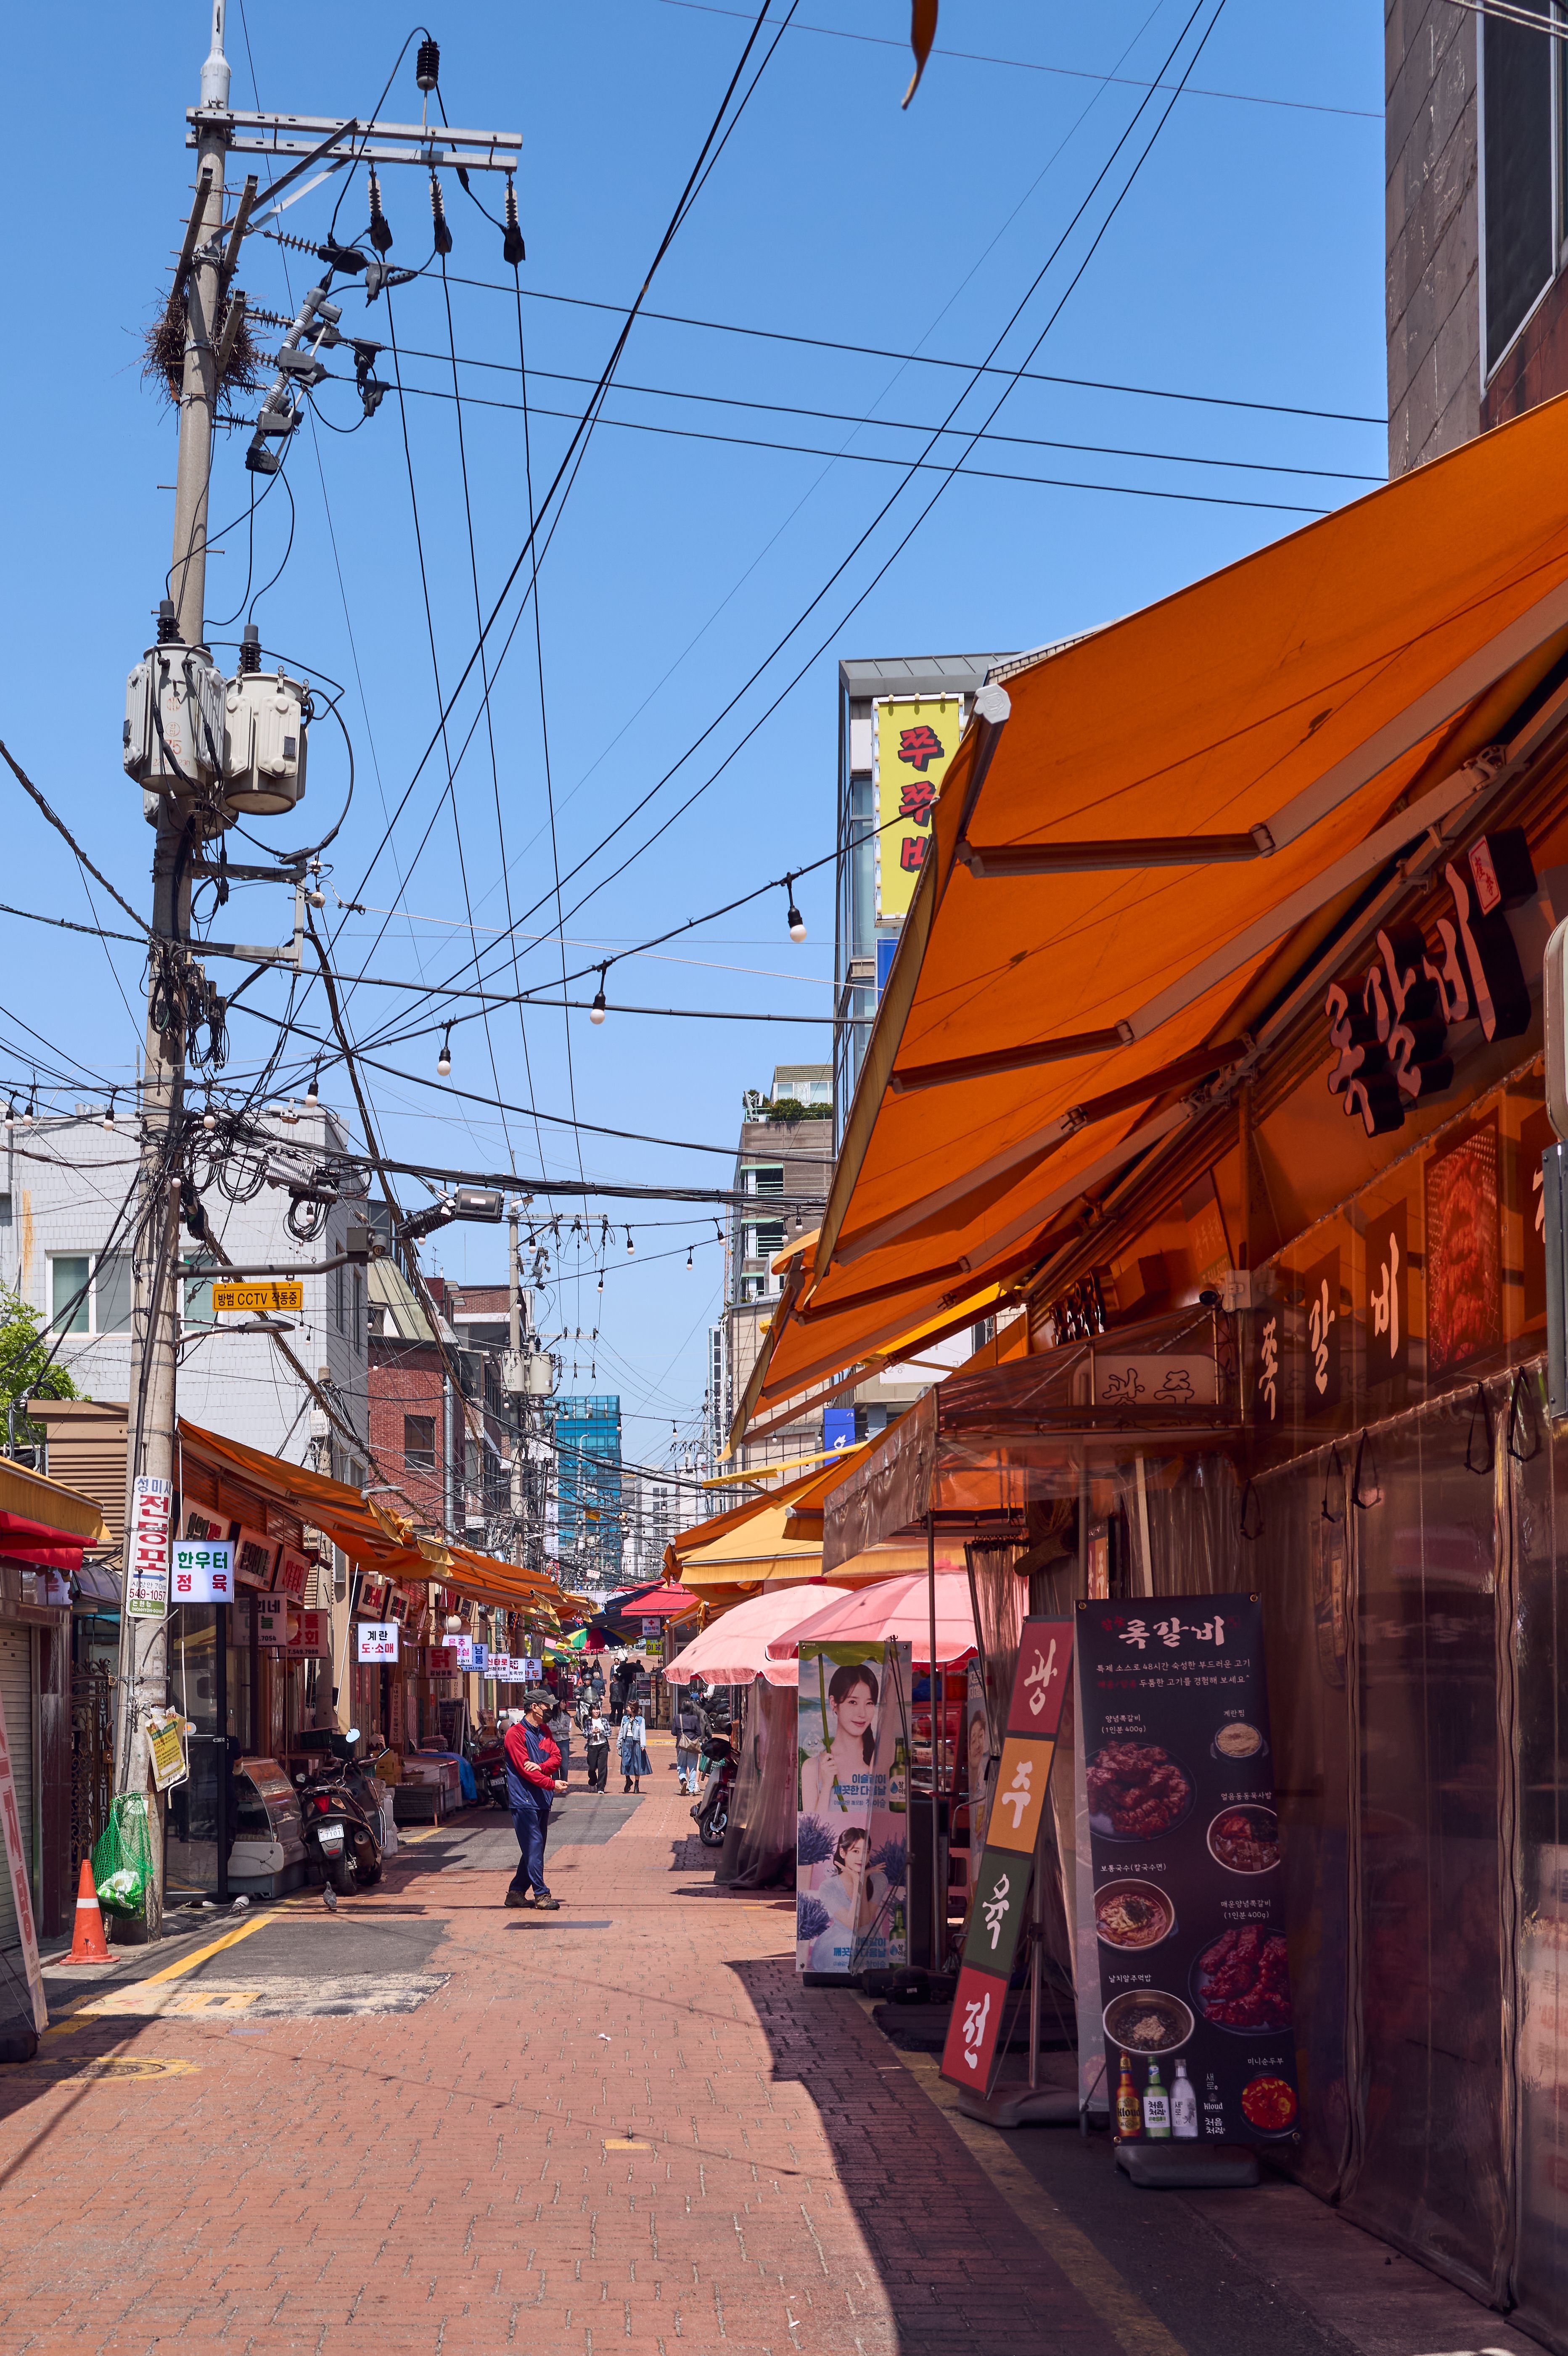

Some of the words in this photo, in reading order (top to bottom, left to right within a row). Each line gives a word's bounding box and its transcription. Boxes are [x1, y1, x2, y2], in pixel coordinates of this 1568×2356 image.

[218, 1293, 234, 1306] 방범
[238, 1293, 267, 1306] CCTV
[272, 1292, 297, 1305] 작동중
[177, 1551, 228, 1569] 한우터
[130, 1588, 166, 1601] 549-1057
[367, 1631, 388, 1641] 계란
[431, 1649, 451, 1668] 닭
[527, 1660, 535, 1669] 손
[1096, 1664, 1113, 1673] 특제
[1115, 1663, 1141, 1672] 소스로
[1142, 1662, 1170, 1671] 48시간
[1171, 1661, 1196, 1671] 숙성한
[1198, 1661, 1232, 1669] 부드러운
[1235, 1658, 1251, 1668] 고기
[1139, 1679, 1164, 1688] 두툼한
[1166, 1677, 1192, 1686] 고기를
[1193, 1676, 1218, 1686] 경험해
[1223, 1709, 1245, 1718] 계란찜
[1101, 1726, 1124, 1735] (1인분
[1124, 1725, 1147, 1734] 400g)
[833, 1785, 859, 1795] 깨끗한
[1224, 1911, 1246, 1920] (1인분
[1248, 1910, 1269, 1920] 400g)
[1108, 1973, 1152, 1983] 날치알주먹밥
[1247, 2057, 1284, 2066] 미니순두부
[1205, 2118, 1223, 2126] 처음
